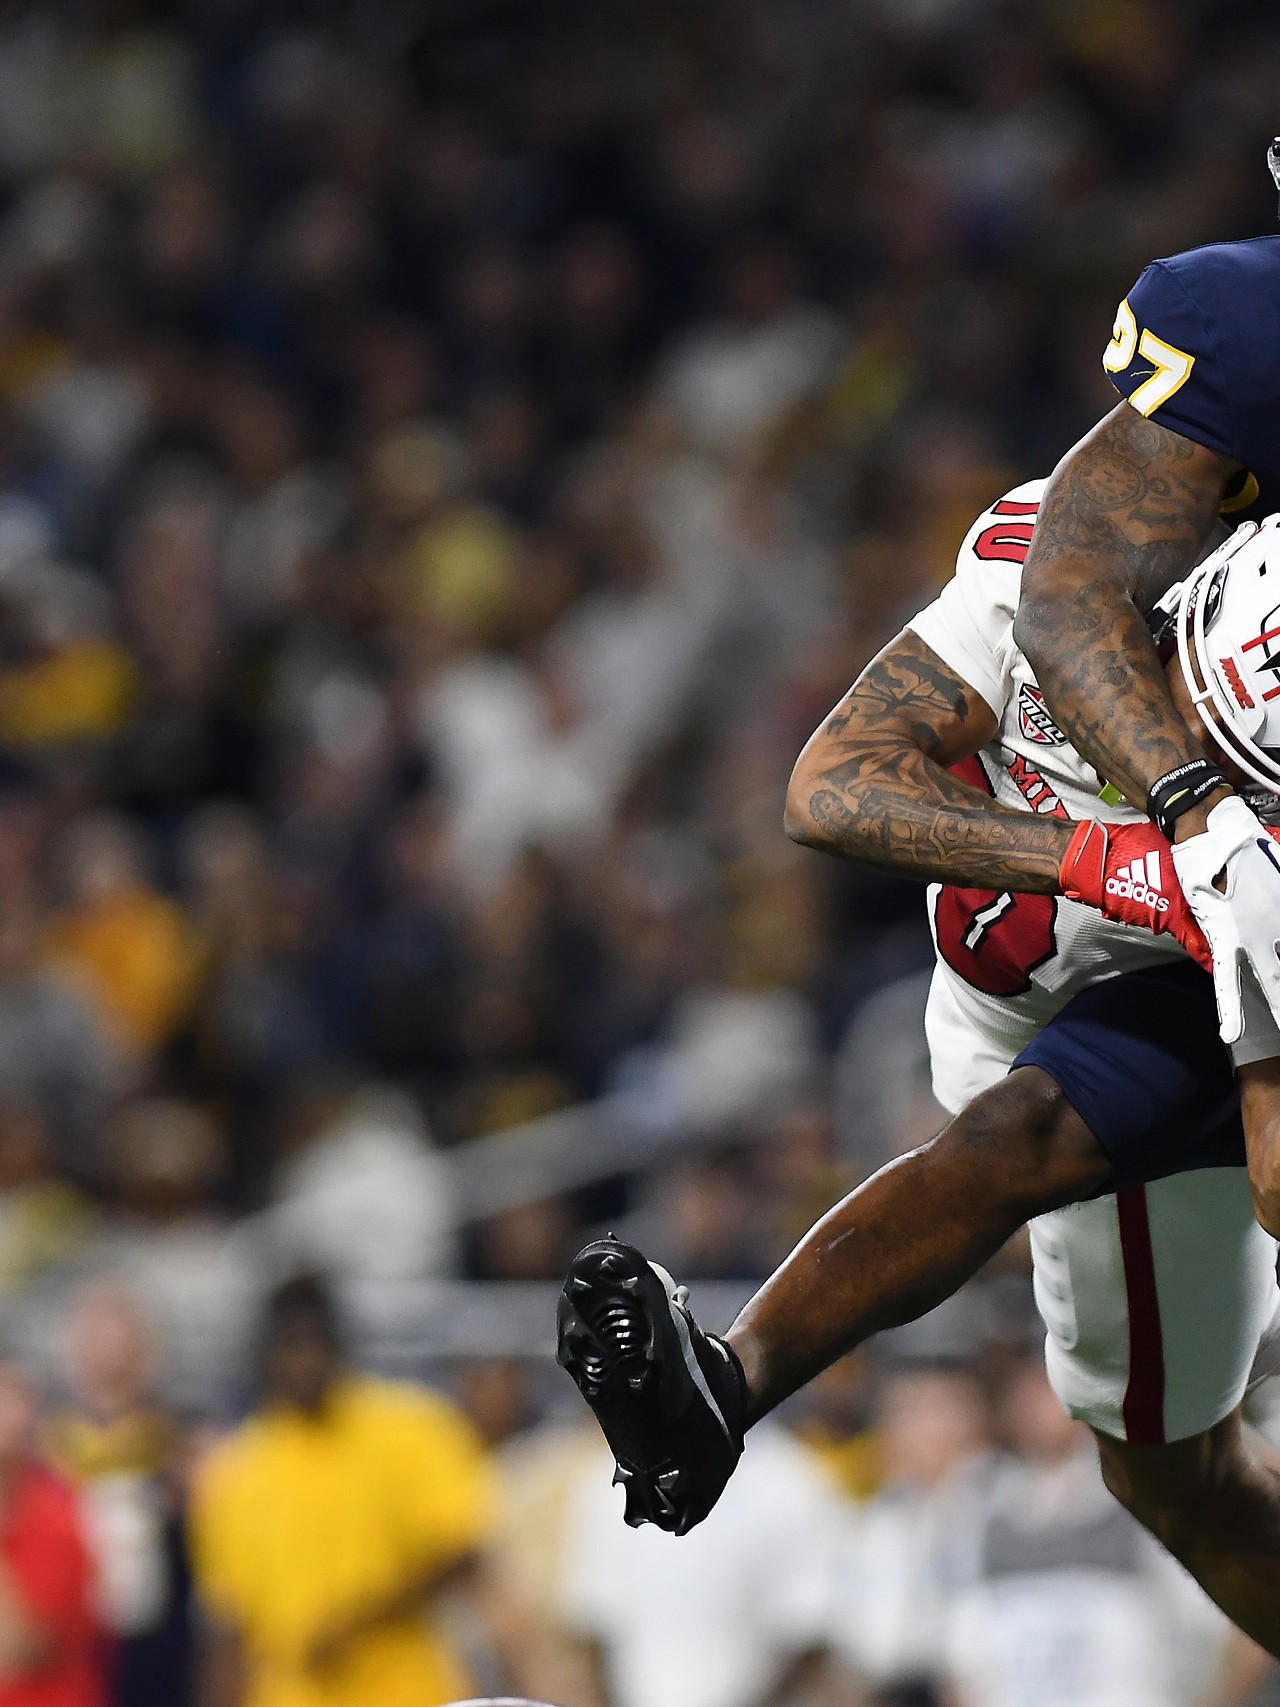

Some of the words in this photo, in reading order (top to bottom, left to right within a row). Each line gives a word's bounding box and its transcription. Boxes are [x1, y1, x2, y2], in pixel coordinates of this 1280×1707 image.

[1102, 298, 1196, 419] 27
[1219, 656, 1256, 710] MAC
[1019, 695, 1067, 744] MAC
[1105, 879, 1170, 914] adidas
